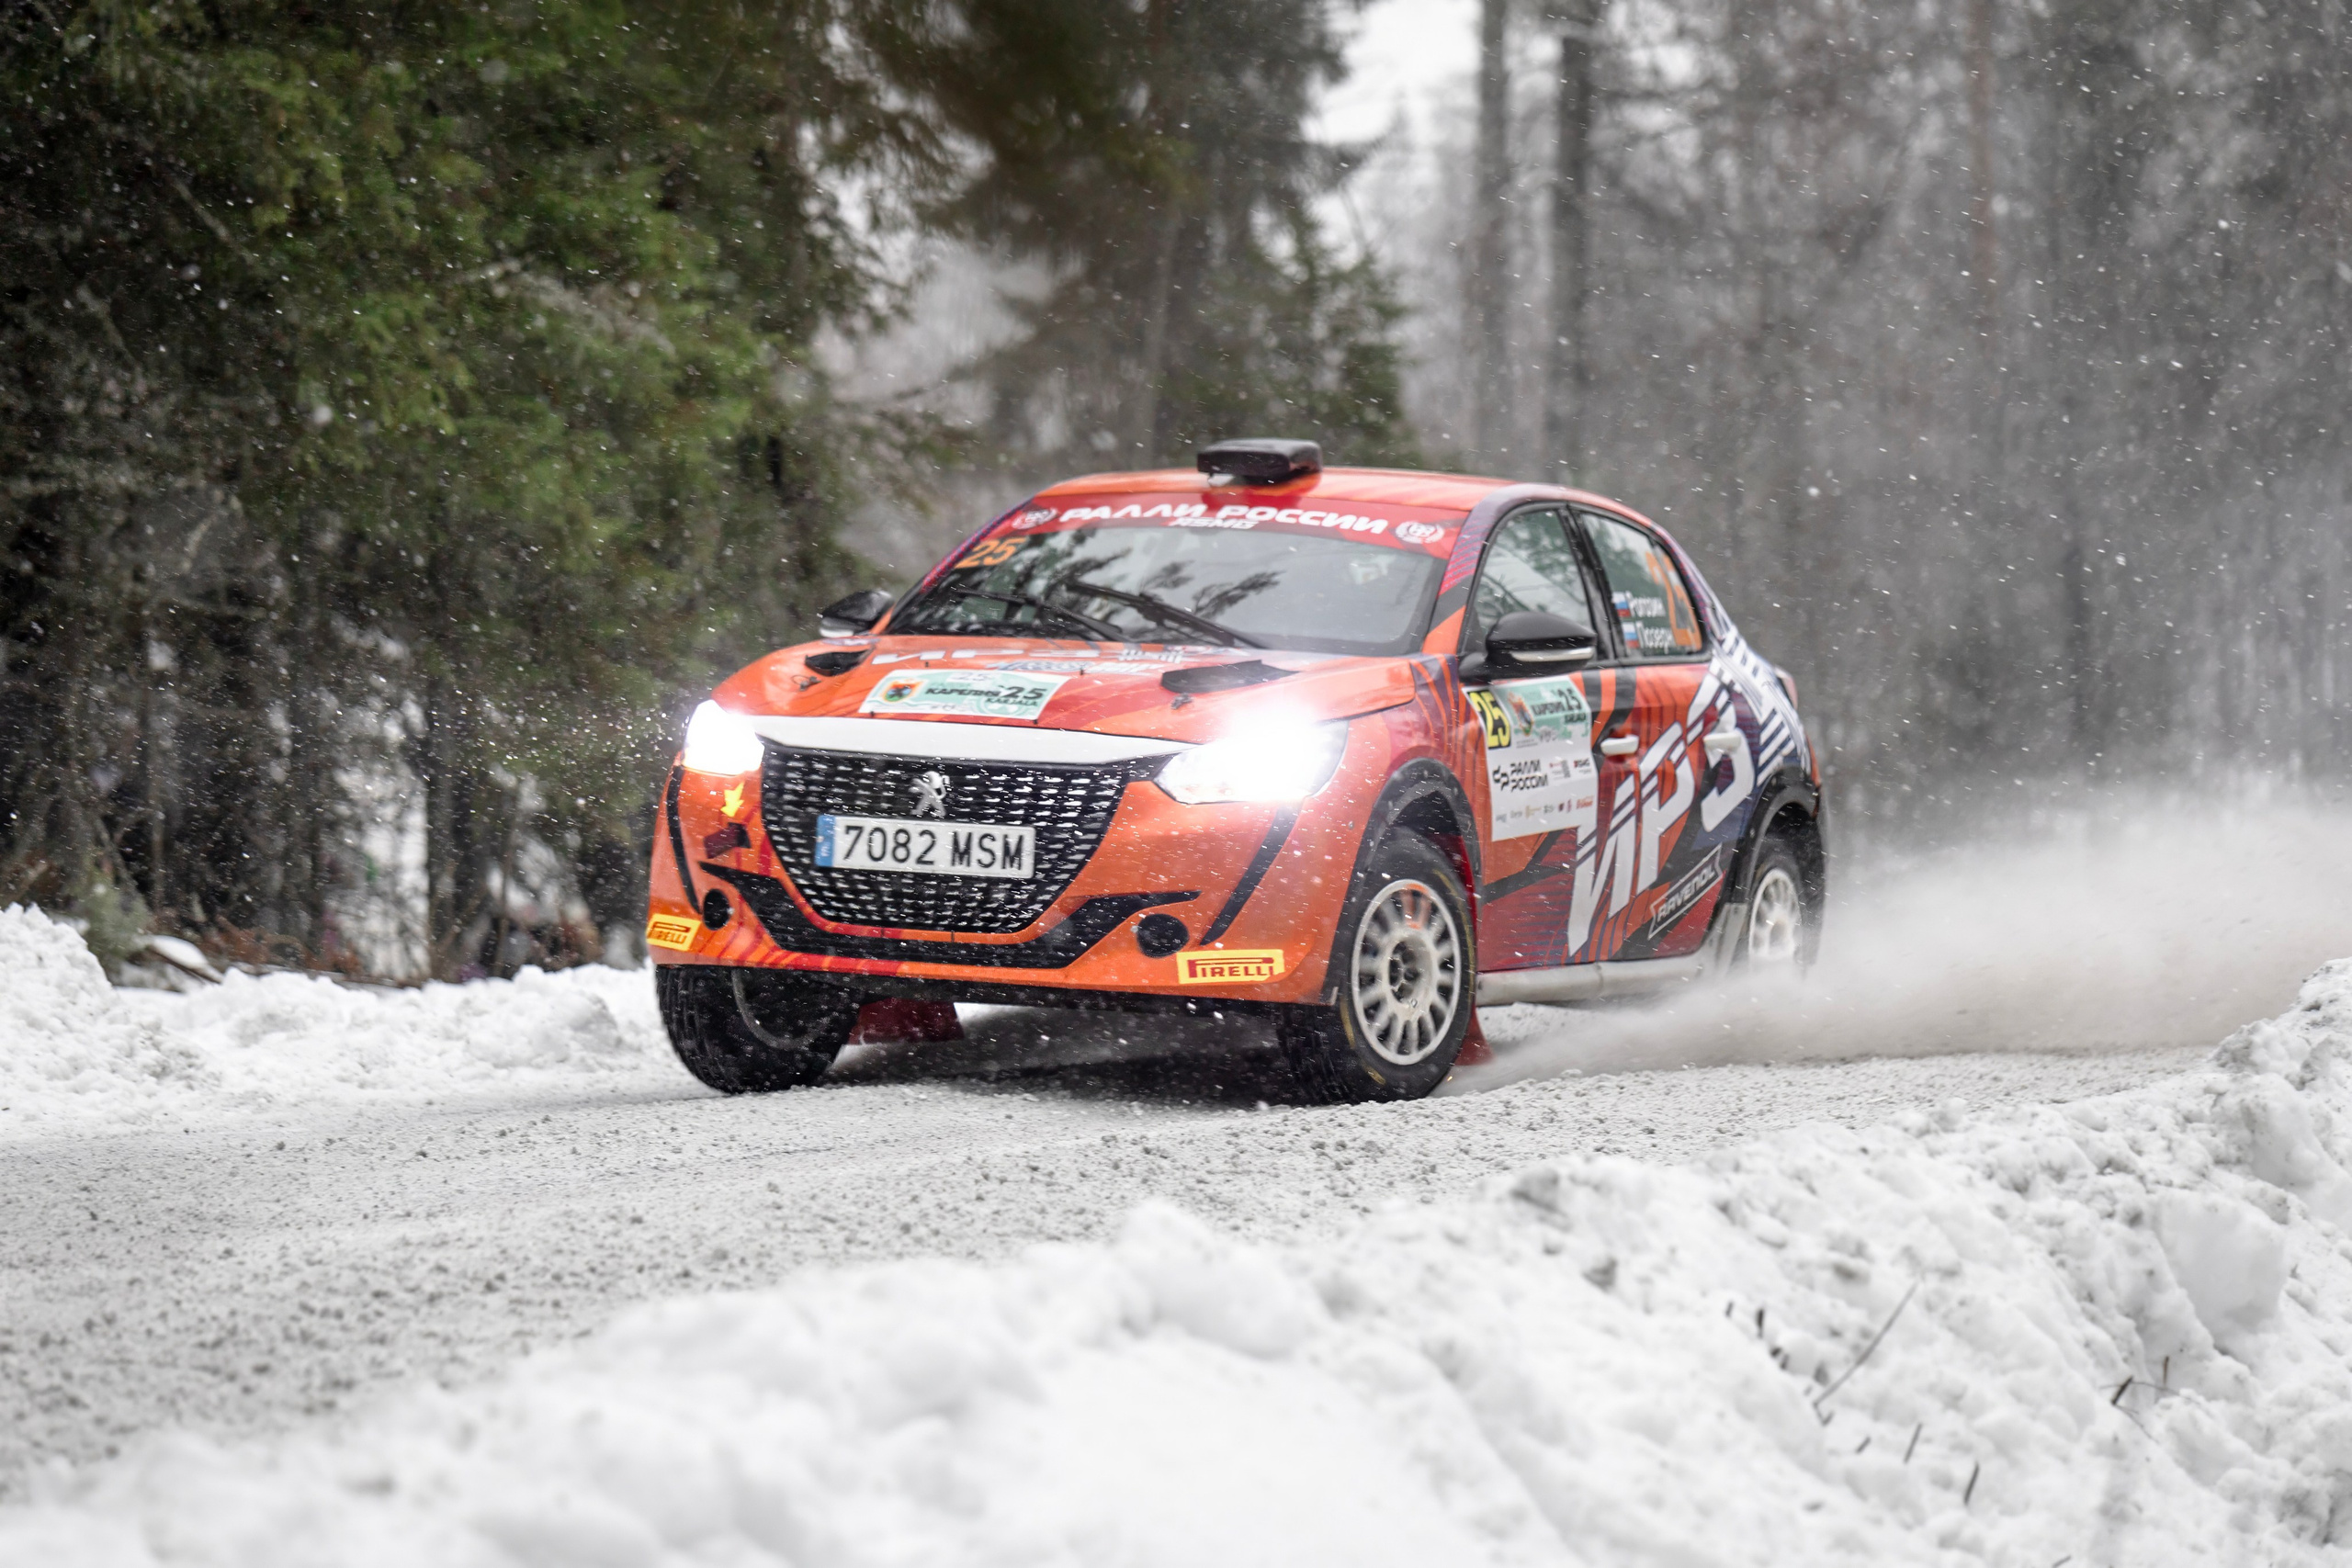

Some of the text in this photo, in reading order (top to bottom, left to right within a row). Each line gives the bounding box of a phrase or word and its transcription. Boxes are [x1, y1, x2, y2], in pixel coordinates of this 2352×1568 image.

[1059, 503, 1388, 534] РАЛЛИ РОССИИ
[954, 537, 1027, 570] 25
[1470, 691, 1511, 748] 25
[842, 826, 1023, 870] 7082 MSM
[1657, 864, 1716, 923] RAVENOL
[1187, 957, 1274, 978] PIRELLI
